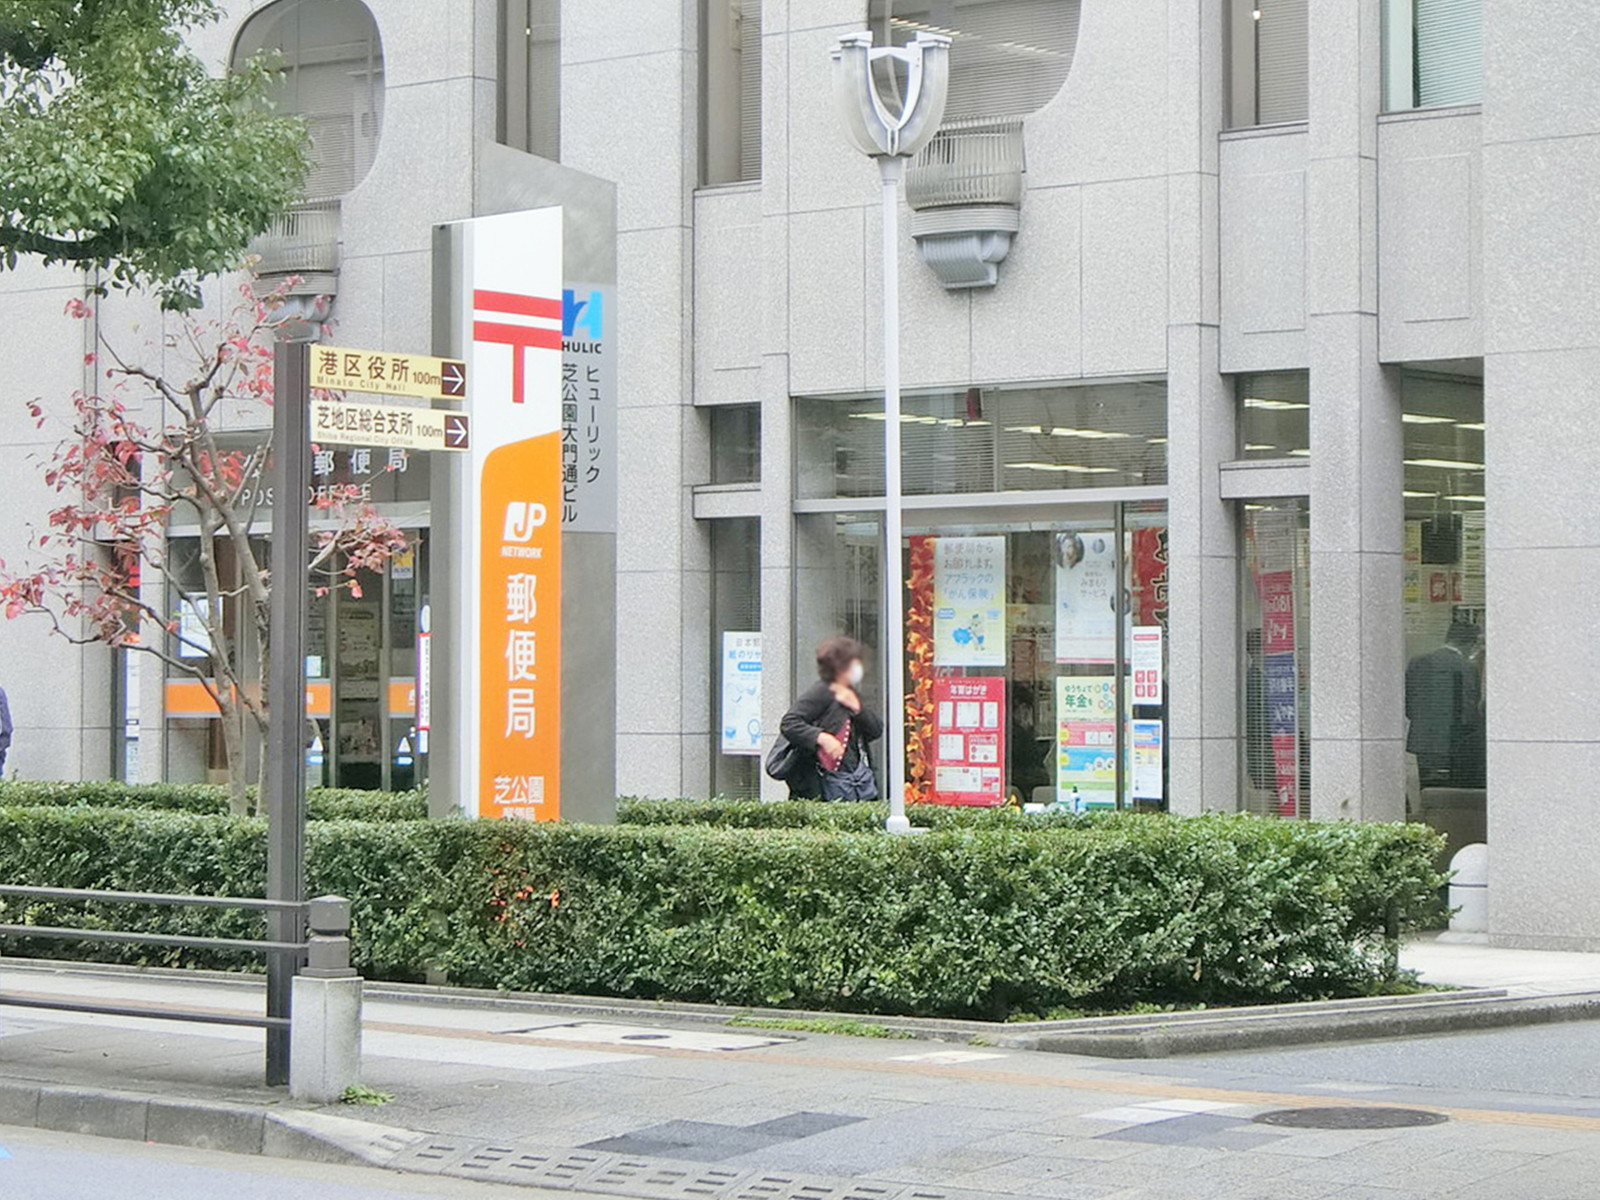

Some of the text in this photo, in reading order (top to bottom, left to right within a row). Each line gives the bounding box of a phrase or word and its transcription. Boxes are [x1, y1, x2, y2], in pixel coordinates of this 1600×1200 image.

[561, 341, 602, 354] HULIC
[317, 375, 406, 391] Minato City Hall
[318, 350, 441, 385] 港区役所 100m
[317, 405, 443, 437] 芝地区総合支所 100m
[586, 365, 601, 483] ヒューリック
[561, 362, 578, 522] 芝公園大門通ビル
[313, 448, 409, 476] 郵便局
[503, 501, 547, 542] JP
[500, 545, 542, 558] NETWORK
[504, 572, 537, 739] 郵便局
[493, 775, 545, 804] 芝公園
